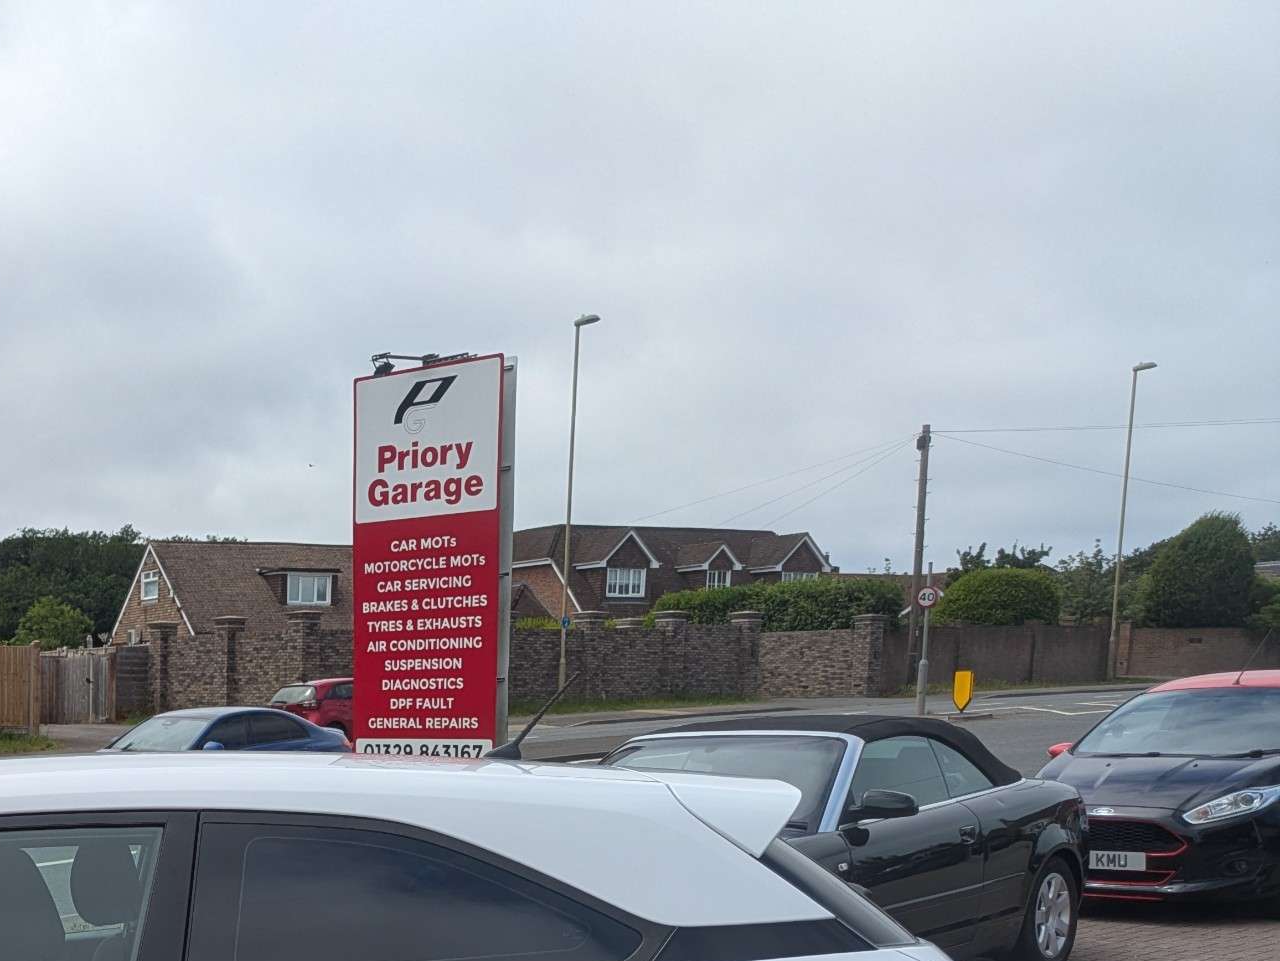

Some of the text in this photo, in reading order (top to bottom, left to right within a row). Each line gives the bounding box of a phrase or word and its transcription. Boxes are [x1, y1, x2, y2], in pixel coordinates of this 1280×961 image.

[377, 441, 473, 473] Priory
[368, 475, 483, 507] Garage
[390, 536, 456, 552] CAR MOTs
[364, 554, 485, 574] MOTORCYCLE MOTs
[377, 575, 472, 592] CAR SERVICING
[362, 595, 488, 613] BRAKES & CLUTCHES
[919, 593, 934, 601] 40
[367, 616, 482, 632] TYRES & EXHAUSTS
[367, 637, 483, 653] AIR CONDITIONING
[384, 658, 462, 671] SUSPENSION
[382, 678, 464, 691] DIAGNOSTICS
[390, 698, 454, 710] DPF FAULT
[368, 717, 479, 729] GENERAL REPAIRS
[1095, 854, 1128, 868] KMU
